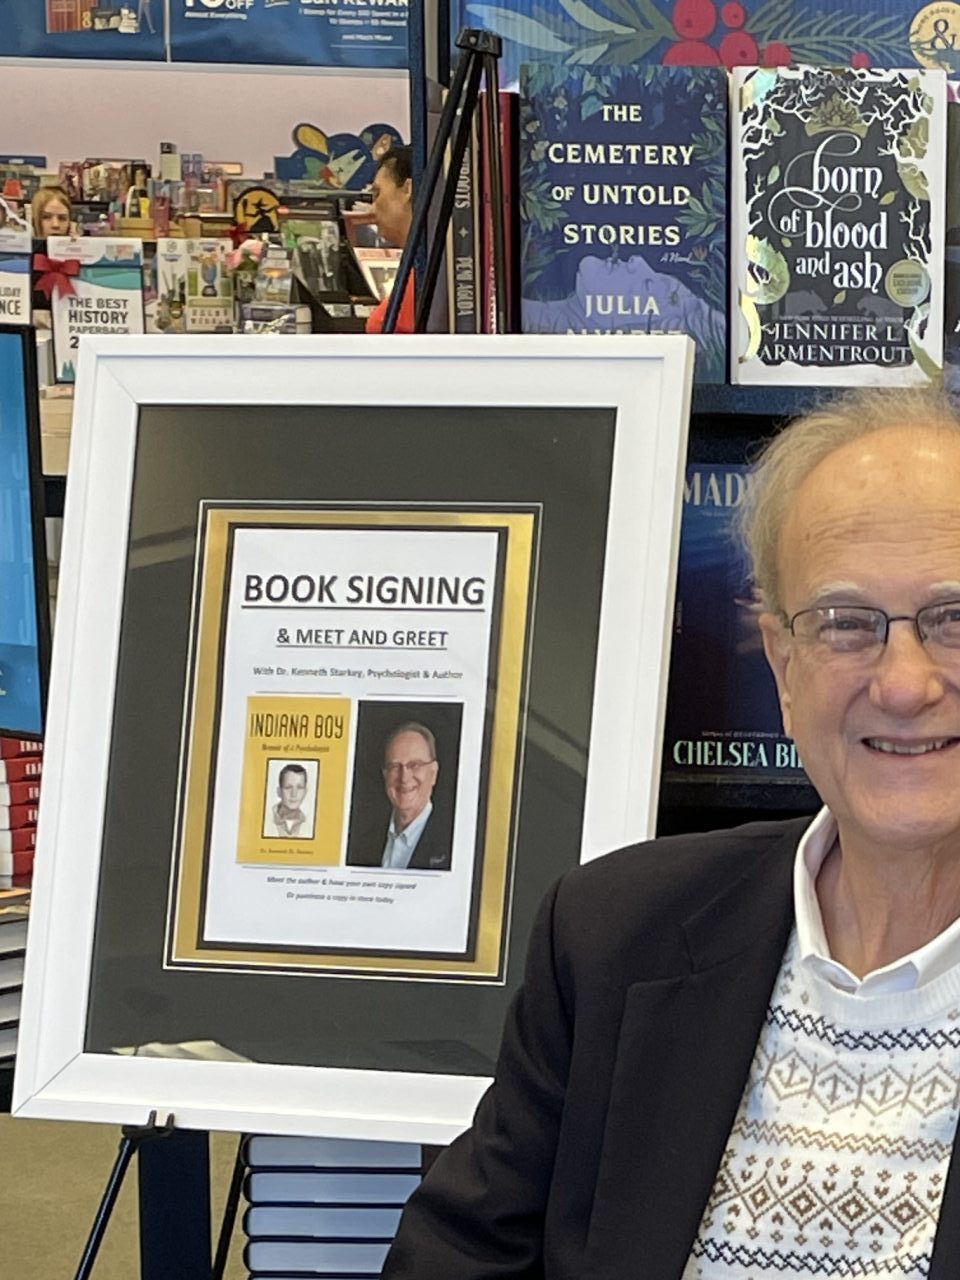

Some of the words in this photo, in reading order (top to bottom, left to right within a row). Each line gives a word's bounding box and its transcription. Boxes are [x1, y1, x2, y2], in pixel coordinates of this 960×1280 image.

[931, 19, 957, 49] &
[603, 105, 643, 122] THE
[548, 143, 695, 166] CEMETERY
[812, 133, 884, 199] born
[552, 186, 576, 201] OF
[583, 185, 692, 206] UNTOLD
[563, 224, 682, 246] STORIES
[778, 210, 803, 234] of
[803, 211, 888, 250] blood
[795, 252, 831, 278] and
[832, 252, 884, 294] ash
[68, 298, 92, 310] THE
[96, 299, 128, 310] BEST
[585, 296, 661, 318] JULIA
[68, 311, 129, 325] HISTORY
[771, 323, 879, 342] JENNIFER
[759, 345, 911, 363] ARMENTROUT
[244, 574, 338, 603] BOOK
[346, 575, 486, 605] SIGNING
[276, 628, 290, 644] &
[296, 629, 344, 645] MEET
[348, 630, 387, 646] AND
[392, 631, 448, 647] GREET
[253, 666, 274, 675] With
[276, 667, 289, 676] Dr.
[291, 667, 327, 678] Kenneth
[367, 669, 421, 681] Psychologist
[432, 671, 464, 680] Author
[250, 713, 309, 738] INDIANA
[315, 714, 345, 739] BOY
[673, 741, 768, 766] CHELSEA
